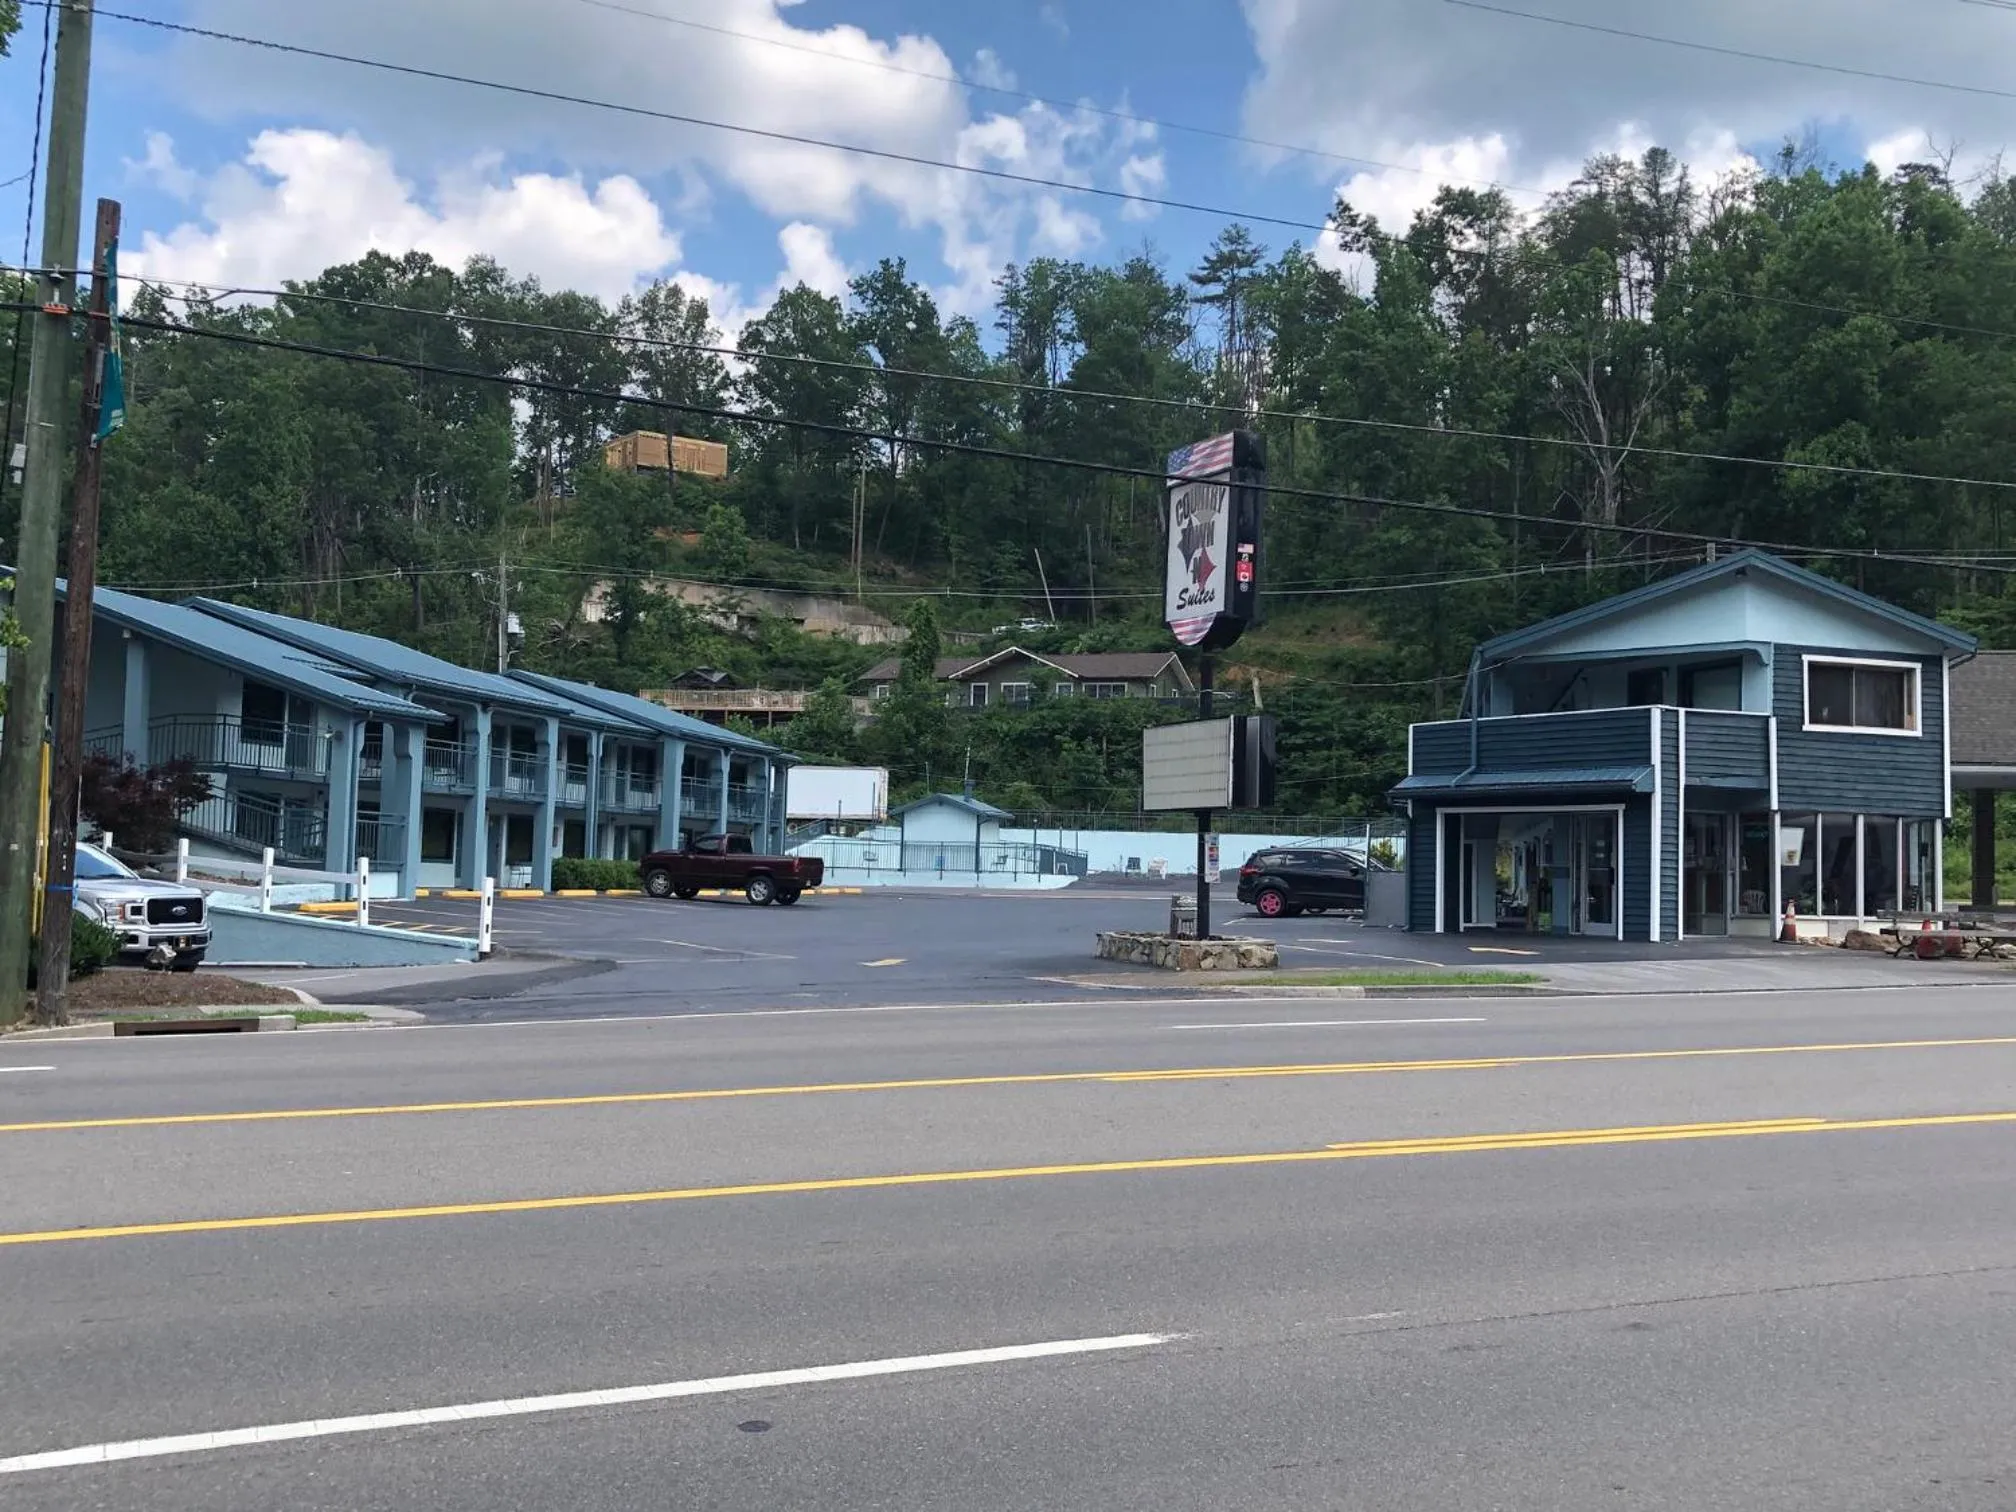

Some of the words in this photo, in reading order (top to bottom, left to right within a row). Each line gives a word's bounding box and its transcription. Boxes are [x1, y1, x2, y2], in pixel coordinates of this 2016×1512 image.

[1175, 485, 1227, 527] COUNTRY
[1181, 520, 1215, 550] TOWN
[1176, 588, 1215, 610] Suites
